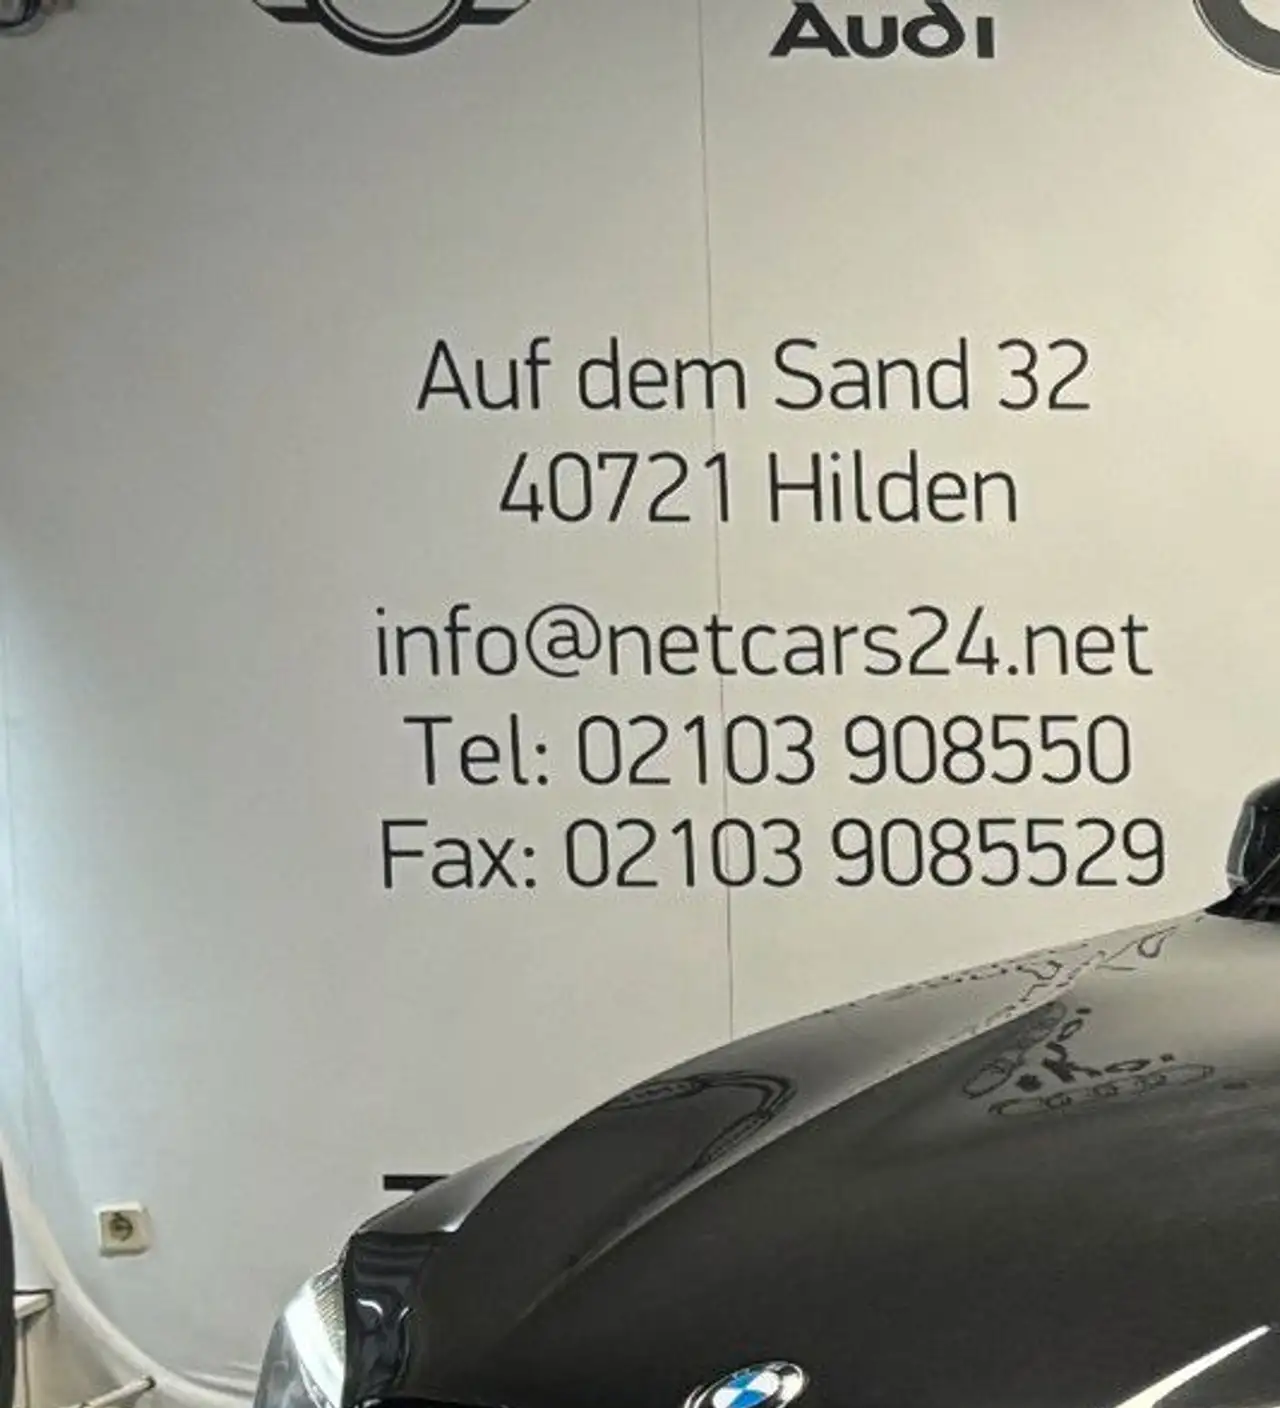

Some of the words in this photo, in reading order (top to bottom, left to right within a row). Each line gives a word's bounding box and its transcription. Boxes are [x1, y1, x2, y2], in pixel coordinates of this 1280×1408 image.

[769, 0, 994, 59] Audi
[417, 336, 551, 410] Auf
[578, 336, 745, 410] dem
[774, 337, 970, 411] Sand
[997, 338, 1091, 410] 32
[499, 450, 729, 523] 40721
[769, 449, 1016, 523] Hilden
[375, 603, 1154, 679] info@netcars24.net
[402, 713, 549, 787] Tel:
[577, 714, 816, 786] 02103
[844, 715, 1131, 786] 908550
[381, 819, 537, 889] Fax:
[565, 818, 803, 888] 02103
[831, 818, 1166, 888] 9085529
